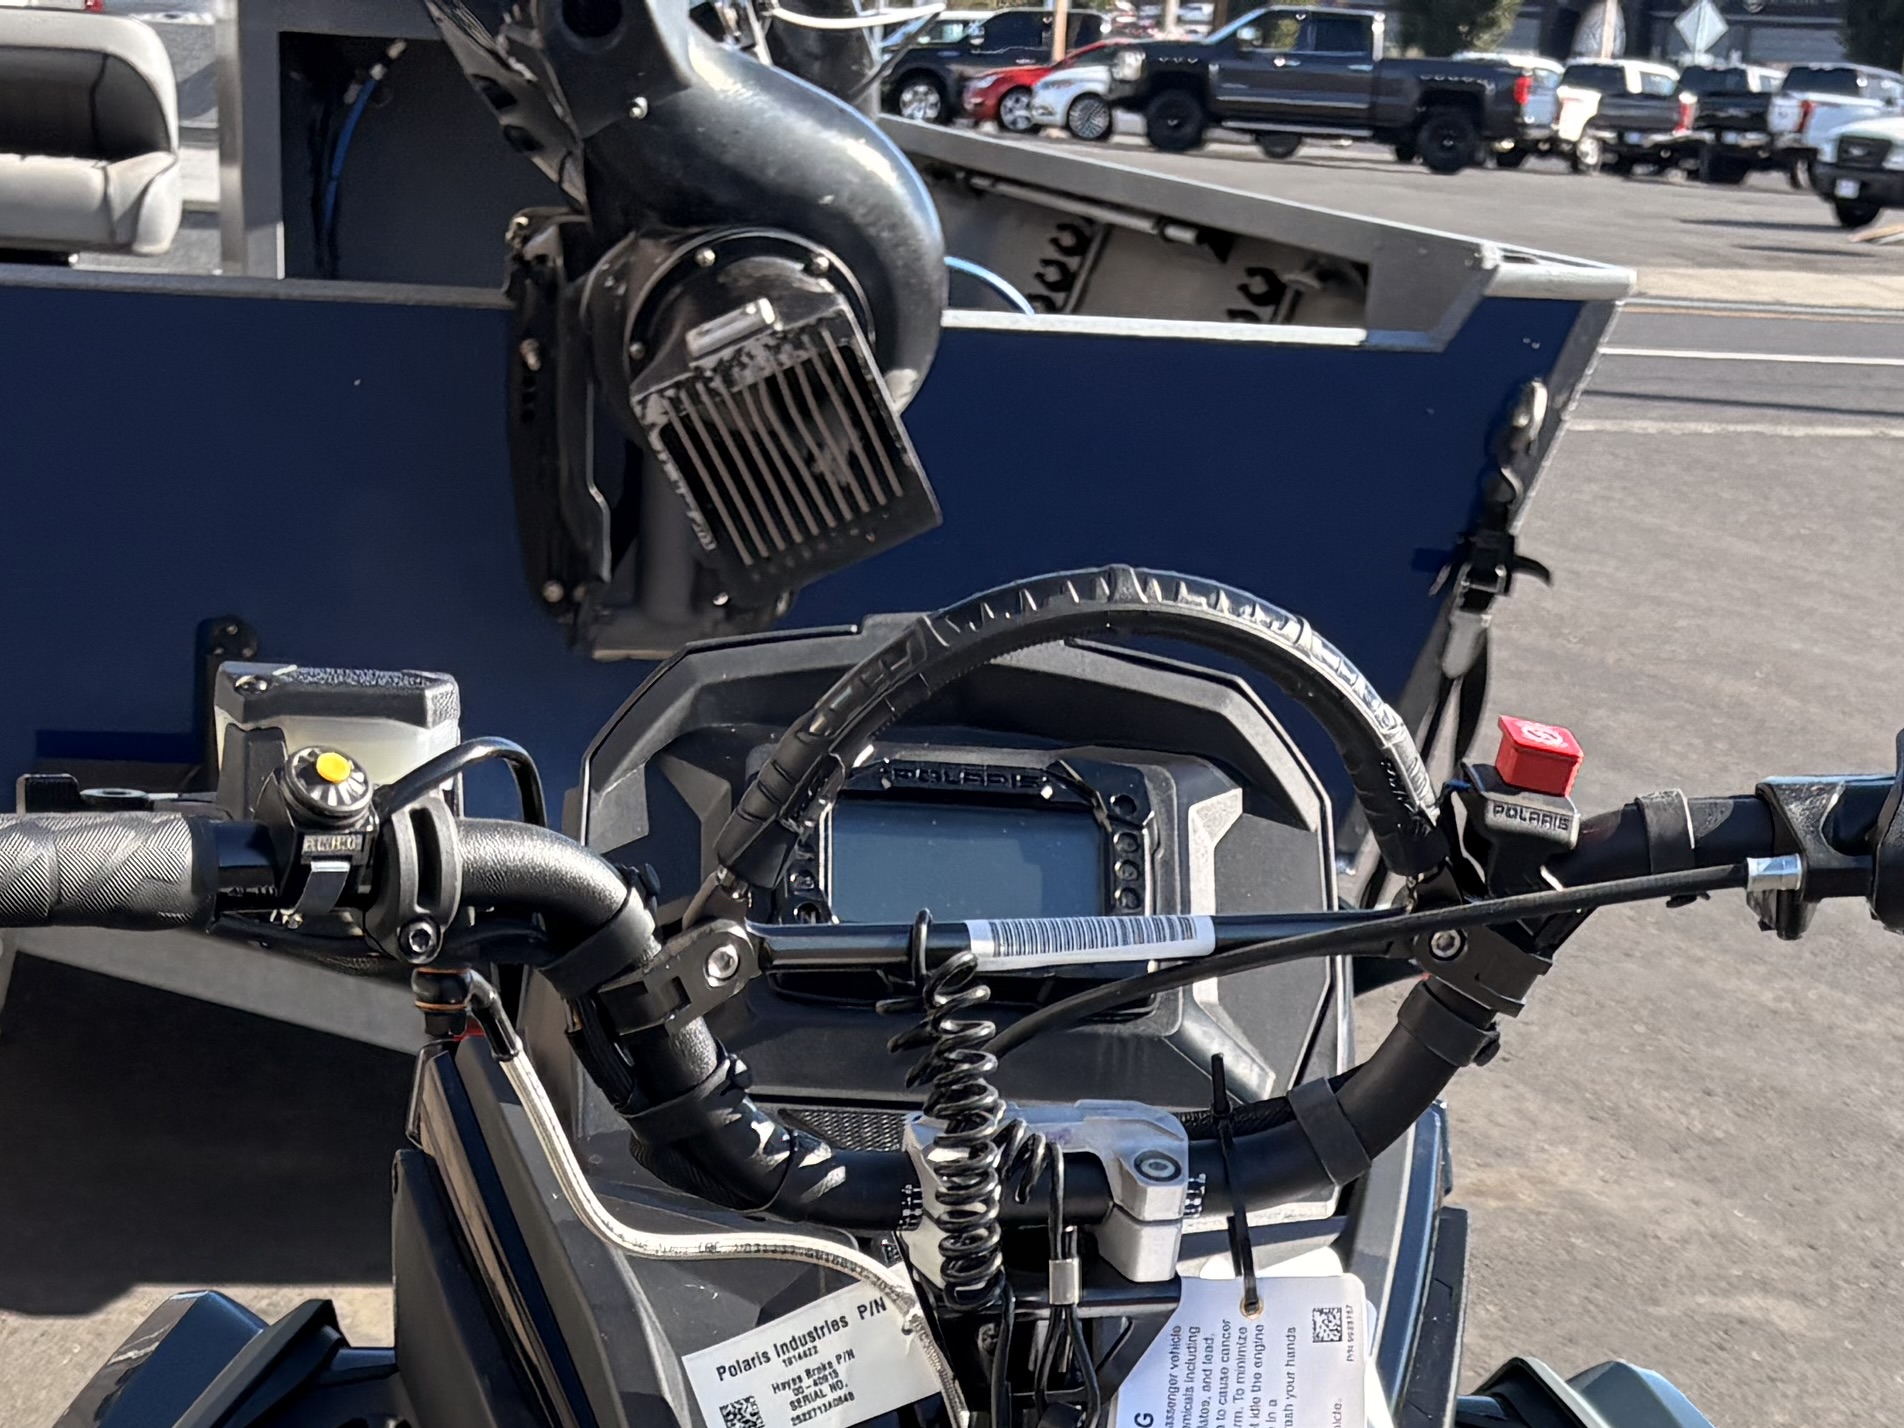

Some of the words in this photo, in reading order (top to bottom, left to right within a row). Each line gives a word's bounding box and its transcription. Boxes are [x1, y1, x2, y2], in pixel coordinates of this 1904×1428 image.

[892, 767, 1047, 788] POLARIS
[1493, 804, 1570, 831] POLARIS
[715, 1347, 772, 1382] Polaris
[771, 1312, 850, 1358] Industries
[855, 1295, 888, 1320] P/N
[1167, 1325, 1182, 1370] vehicle
[1219, 1319, 1232, 1363] cancer
[1252, 1324, 1266, 1368] engine
[1283, 1326, 1296, 1367] hands
[1183, 1325, 1200, 1382] including
[1233, 1326, 1249, 1384] minimize
[788, 1387, 829, 1411] SERIAL
[828, 1377, 849, 1393] NO.
[1199, 1368, 1212, 1392] and
[1217, 1366, 1229, 1405] cause
[1250, 1371, 1262, 1393] the
[1285, 1371, 1297, 1400] your
[1232, 1387, 1244, 1403] To
[1248, 1396, 1260, 1419] idle
[1268, 1398, 1277, 1407] a
[1214, 1408, 1225, 1421] to
[1266, 1410, 1276, 1423] in
